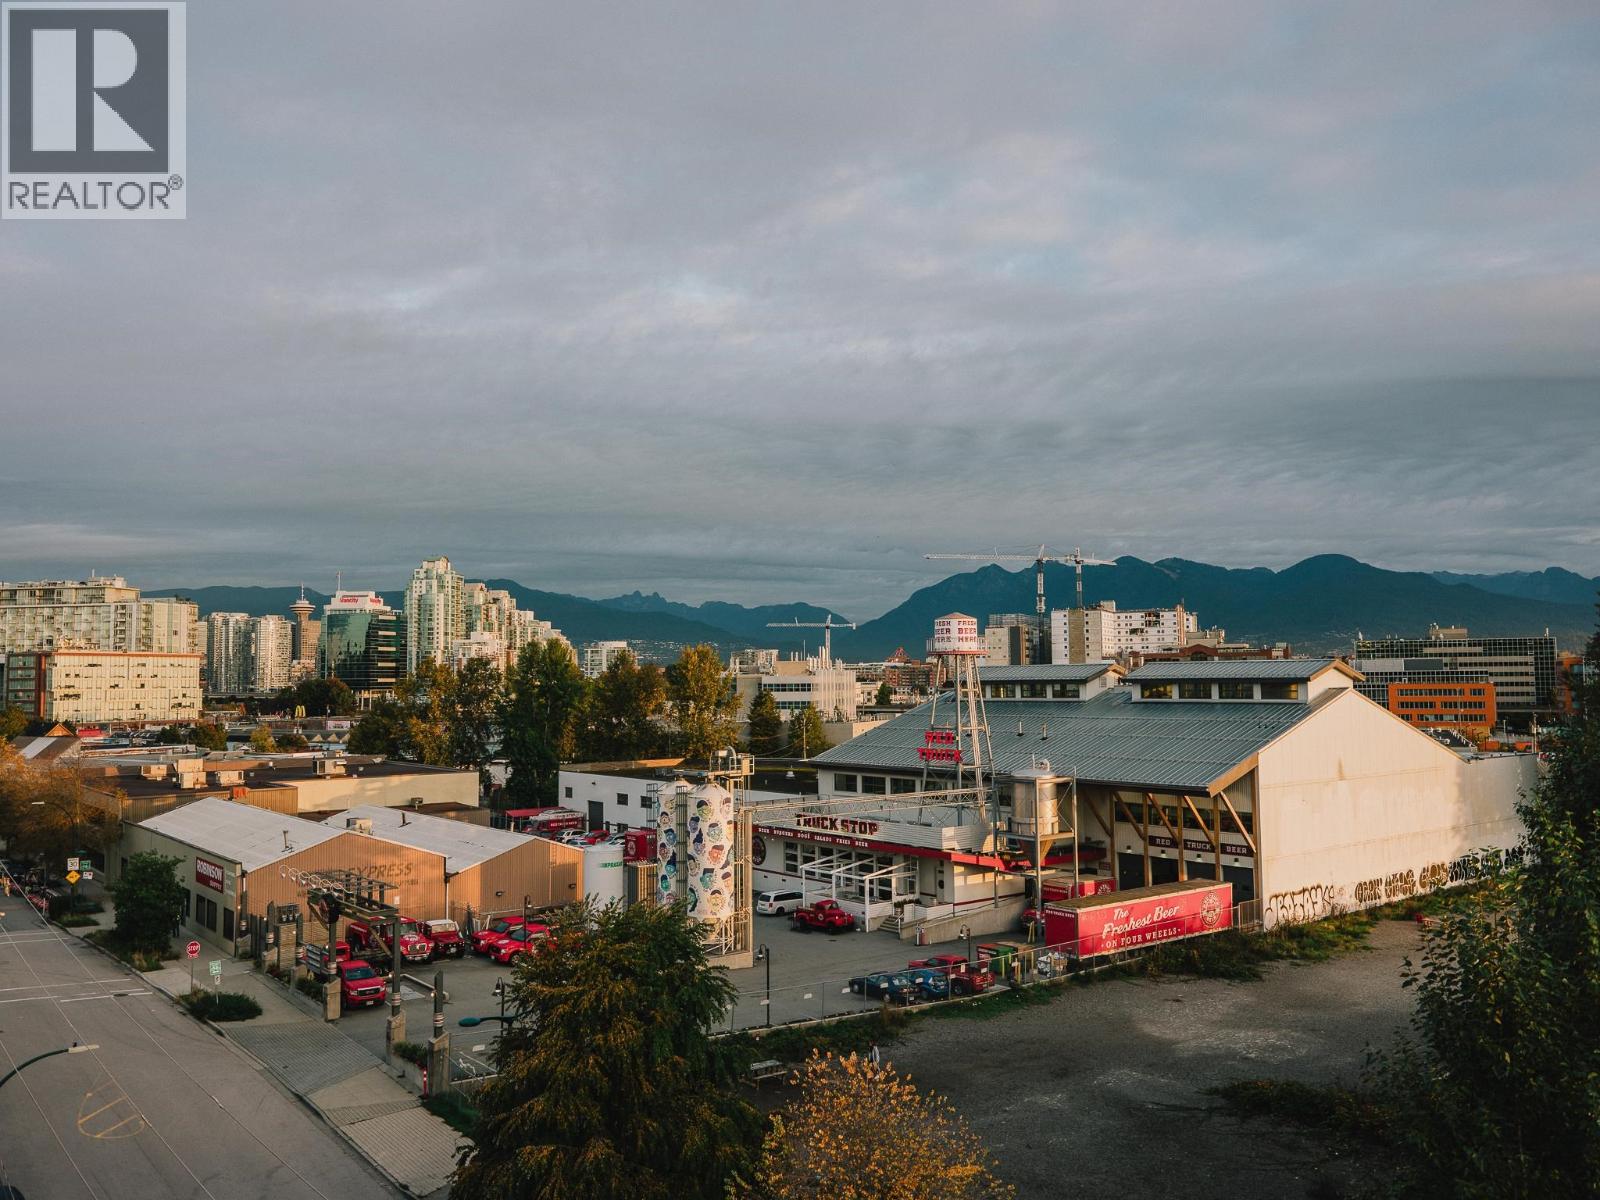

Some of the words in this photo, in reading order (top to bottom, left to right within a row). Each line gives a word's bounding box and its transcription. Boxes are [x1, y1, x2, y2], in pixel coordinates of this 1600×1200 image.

[795, 814, 839, 831] TRUCK
[840, 819, 879, 835] STOP
[1156, 838, 1171, 846] RED
[1186, 841, 1211, 850] TRUCK
[1226, 845, 1247, 854] BEER
[197, 859, 222, 881] ROBINSON
[1113, 908, 1129, 920] The
[1102, 913, 1153, 939] Freshest
[1153, 906, 1180, 922] Beer
[1105, 939, 1118, 949] ON
[1145, 927, 1177, 940] WHEELS
